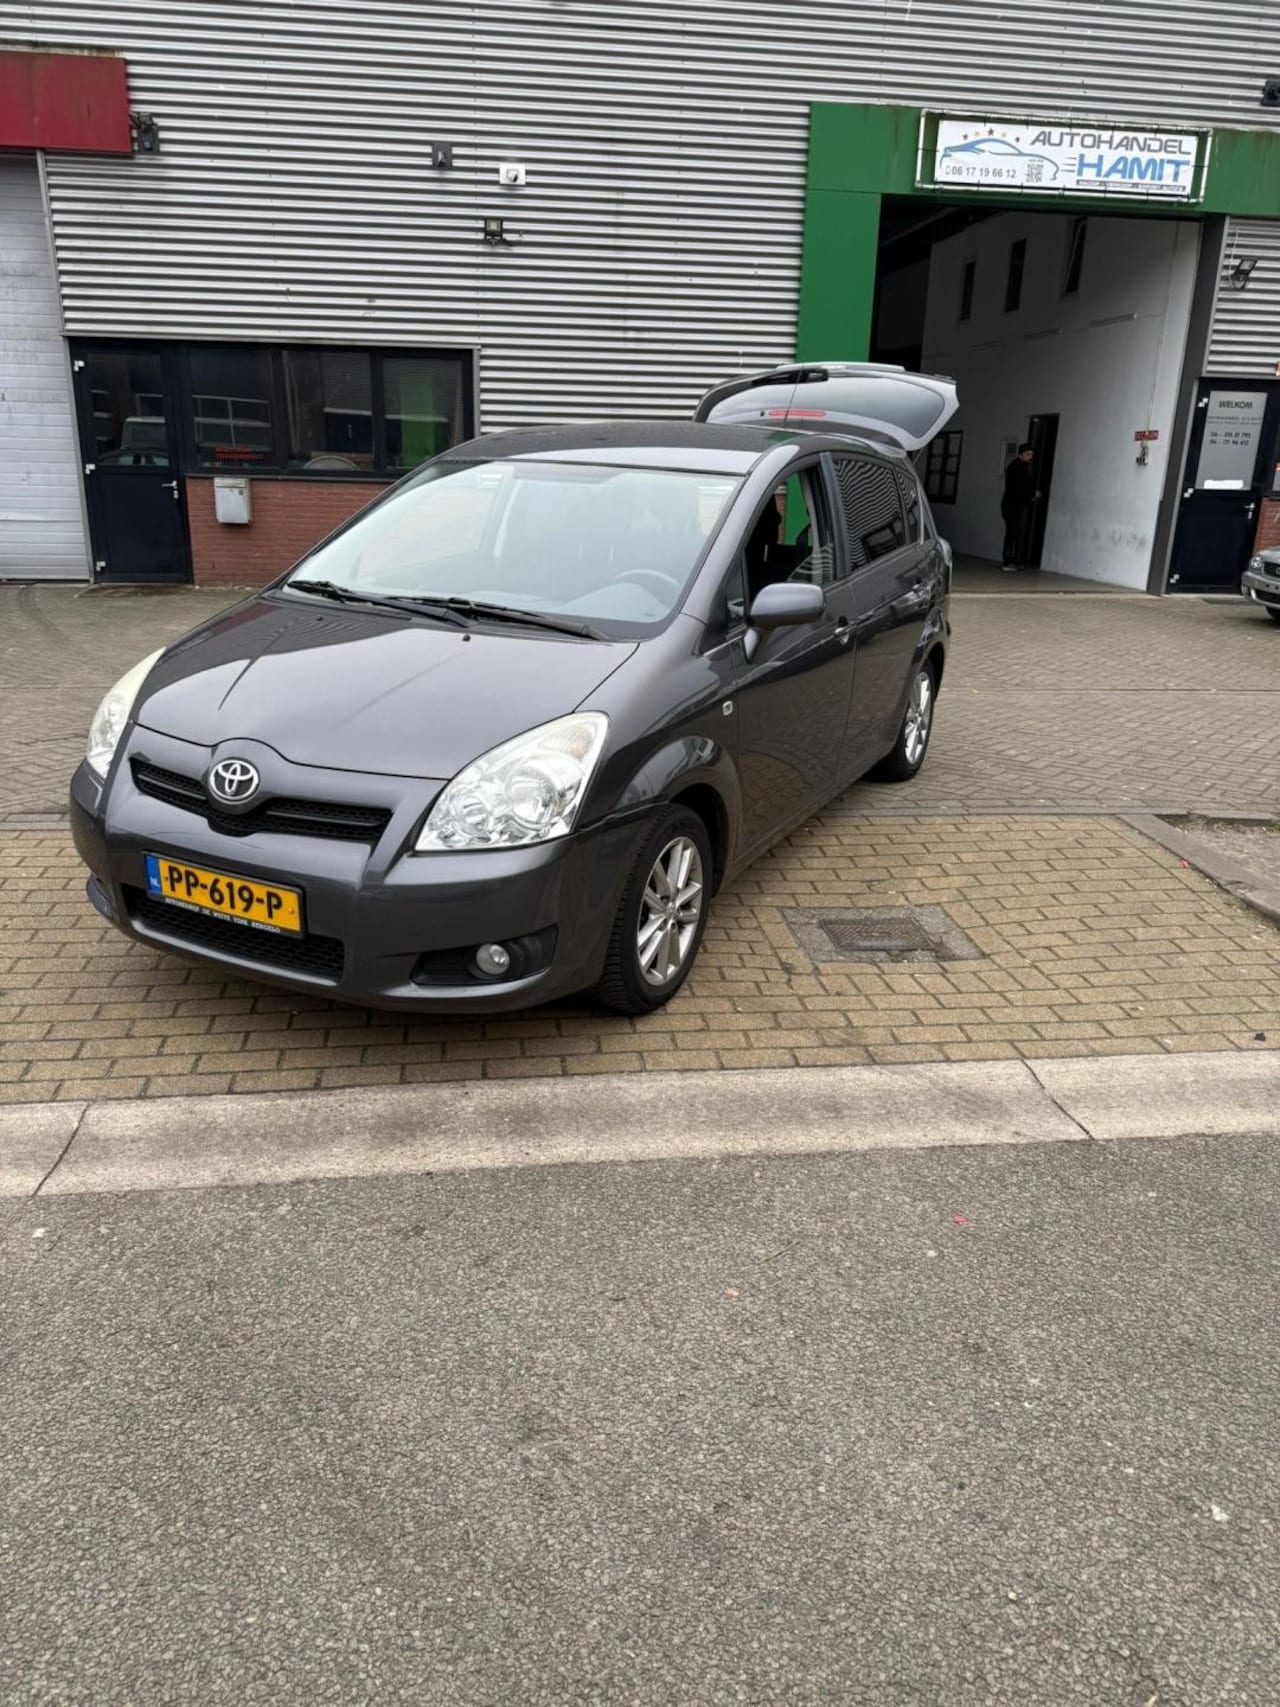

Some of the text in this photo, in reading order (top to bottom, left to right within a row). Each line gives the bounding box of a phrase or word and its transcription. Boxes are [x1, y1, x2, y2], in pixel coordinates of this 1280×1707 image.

[1030, 130, 1192, 155] AUTOHANDEL
[952, 166, 963, 176] 06
[966, 167, 976, 177] 17
[980, 168, 990, 177] 19
[1006, 169, 1017, 179] 12
[1076, 153, 1190, 182] HAMIT
[1219, 401, 1253, 409] WELKOM
[168, 865, 283, 919] PP-619-P
